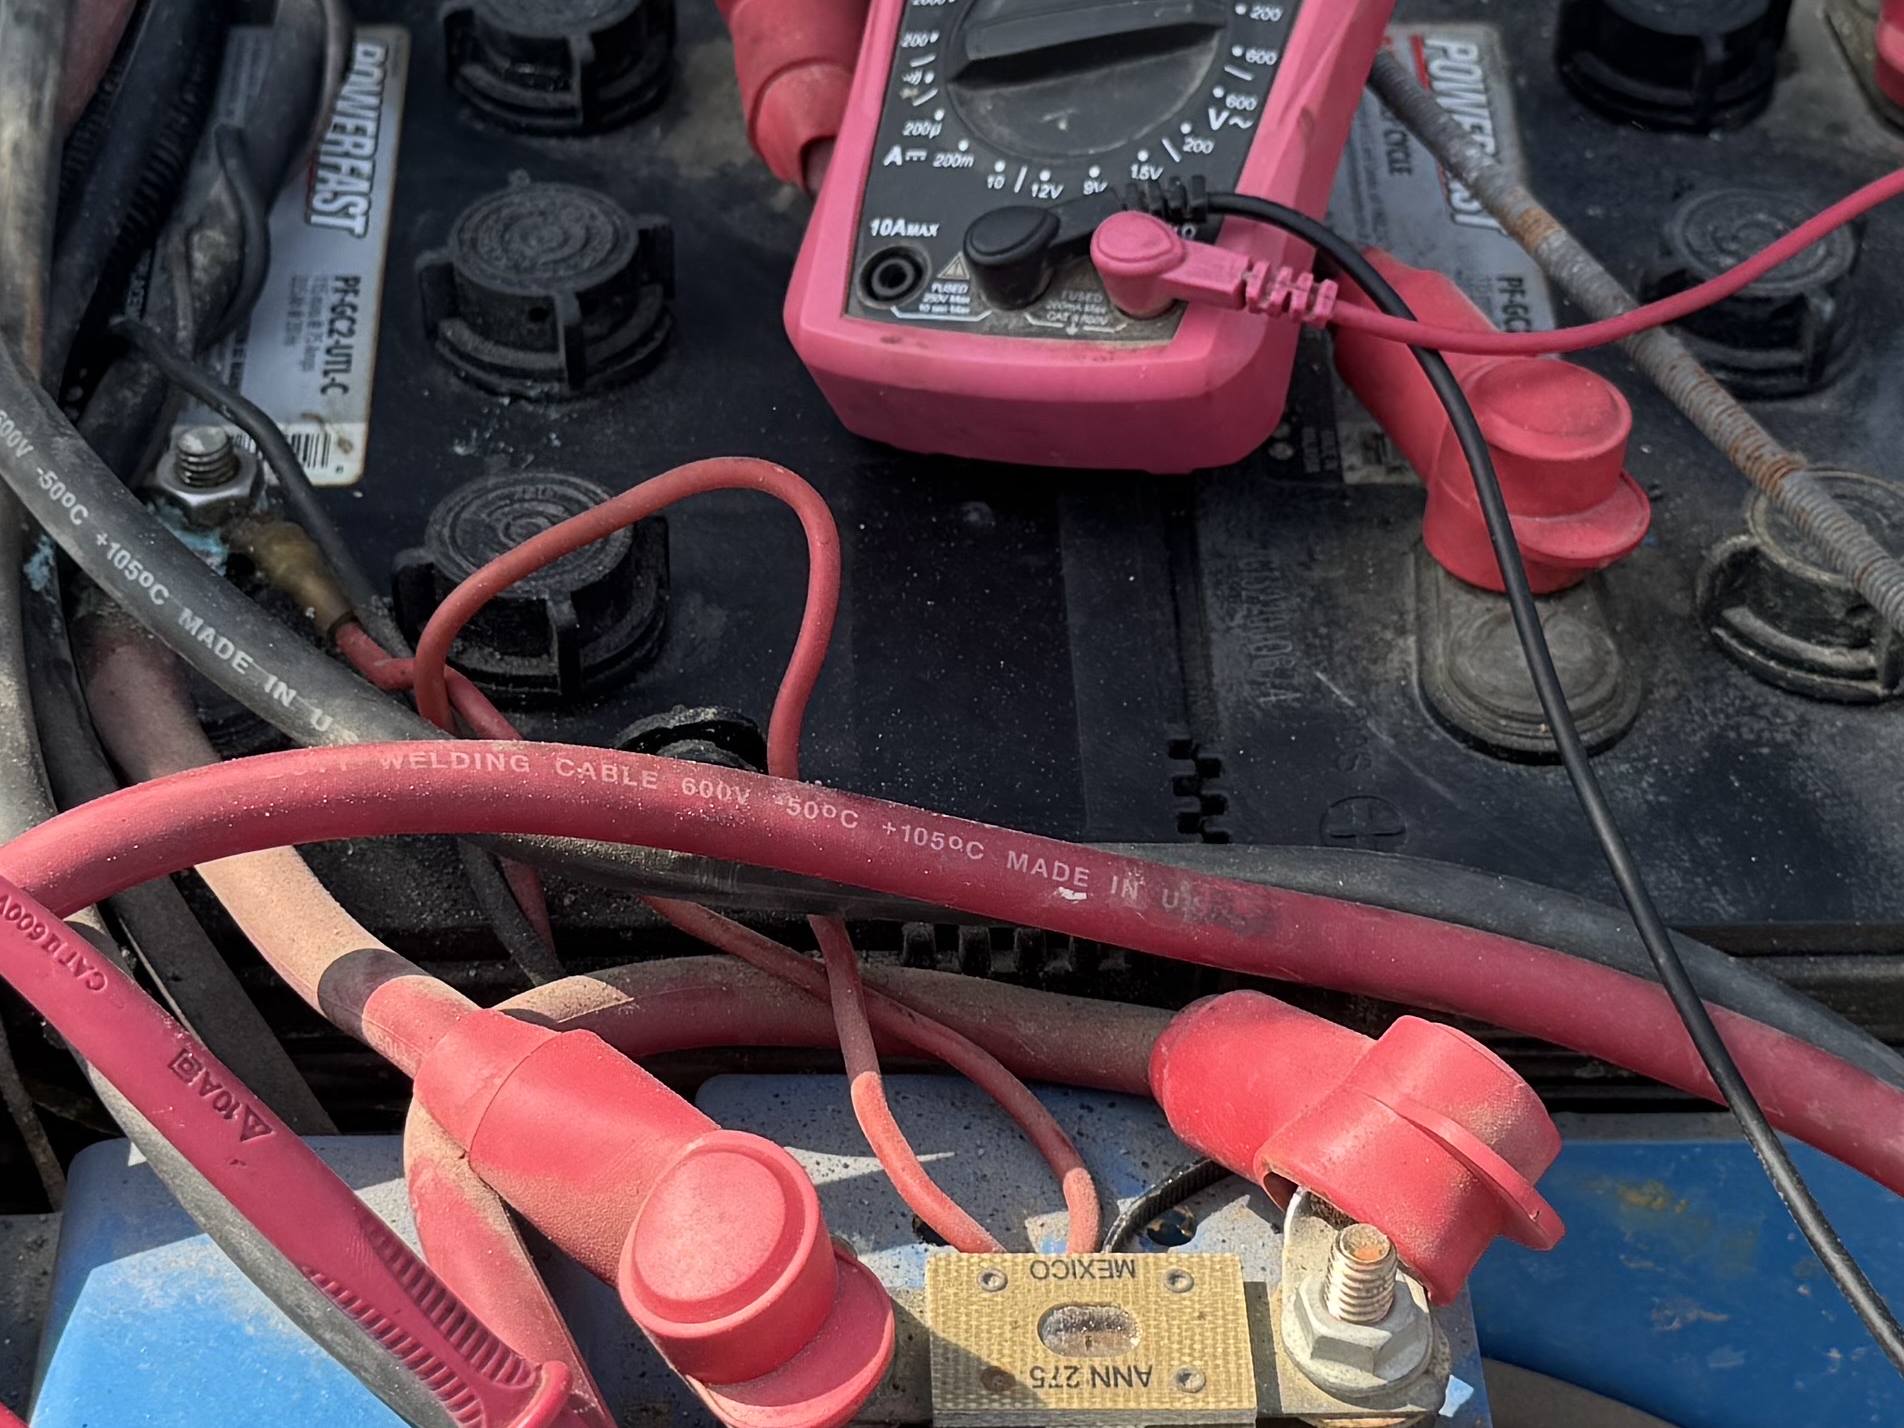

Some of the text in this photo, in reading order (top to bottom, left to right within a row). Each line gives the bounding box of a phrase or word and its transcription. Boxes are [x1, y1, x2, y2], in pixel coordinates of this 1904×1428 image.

[1250, 5, 1283, 22] 200
[1245, 50, 1277, 66] 600
[1225, 94, 1257, 111] 600
[1182, 137, 1215, 155] 200
[932, 151, 975, 169] 200m
[986, 173, 1006, 190] 10
[1030, 182, 1065, 201] 12V
[177, 606, 256, 676] MADE
[262, 673, 298, 708] IN
[379, 750, 532, 774] WELDING
[554, 757, 660, 792] CABLE
[679, 775, 752, 808] 600V
[1006, 848, 1092, 889] MADE
[1110, 873, 1141, 903] IN
[198, 1069, 242, 1121] 10A
[1029, 1258, 1137, 1281] MEXICO
[1028, 1364, 1154, 1390] ANN 275
